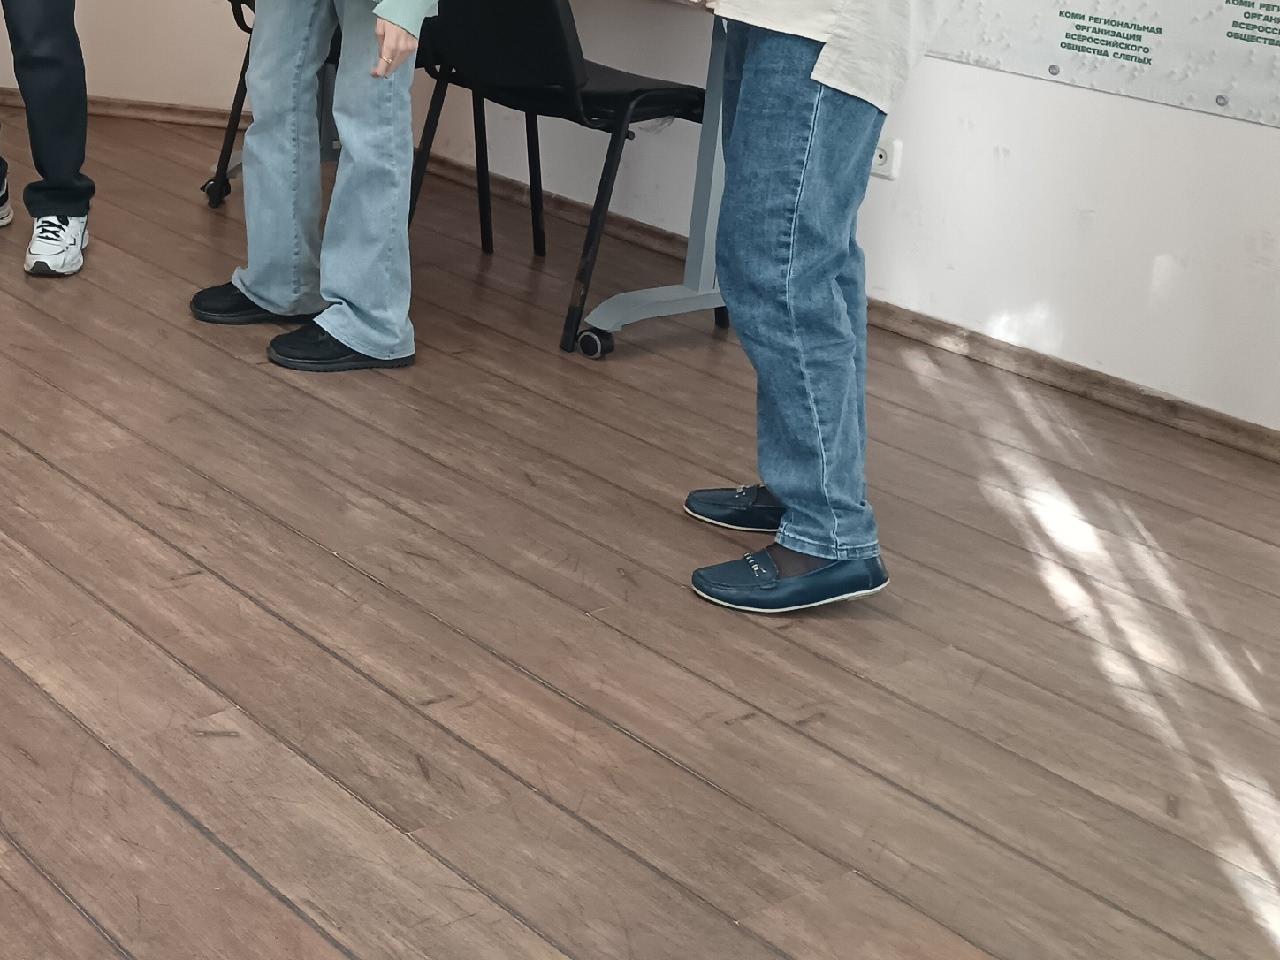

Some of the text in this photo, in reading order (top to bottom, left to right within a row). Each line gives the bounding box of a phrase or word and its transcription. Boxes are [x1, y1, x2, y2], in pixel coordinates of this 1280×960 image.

[1059, 10, 1162, 34] КОМИ РЕГИОНАЛЬНАЯ
[1232, 21, 1280, 36] ВСЕРОСС
[1065, 32, 1149, 53] ВСЕРОССИЙСКОГО
[1075, 24, 1142, 42] ОРГАНИЗАЦИЯ
[1060, 42, 1152, 65] ОБЩЕСТВА СЛЕПЫХ
